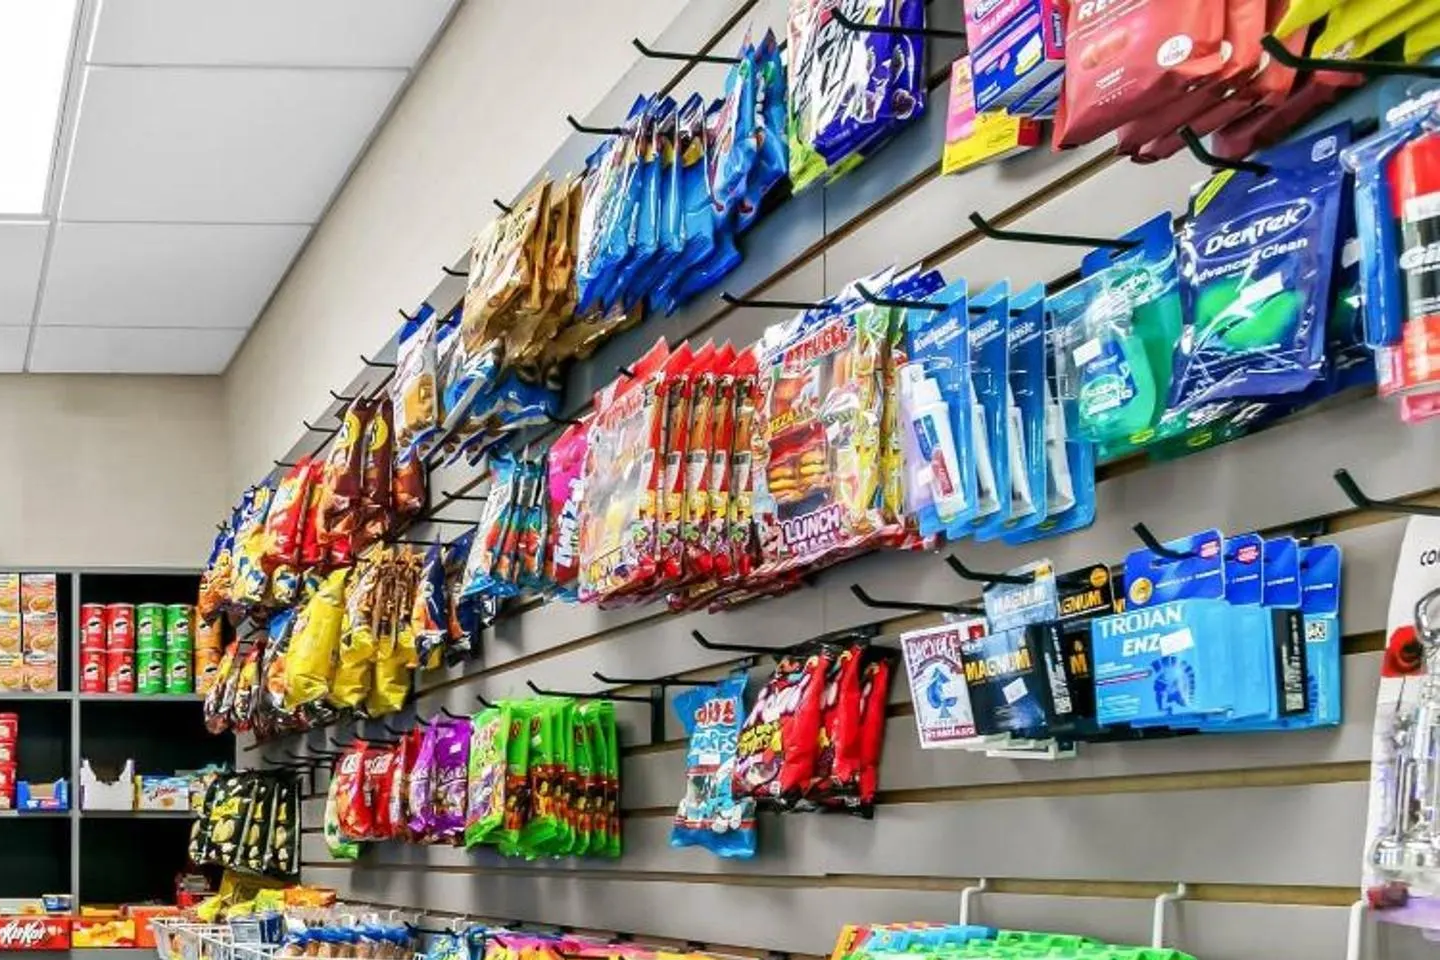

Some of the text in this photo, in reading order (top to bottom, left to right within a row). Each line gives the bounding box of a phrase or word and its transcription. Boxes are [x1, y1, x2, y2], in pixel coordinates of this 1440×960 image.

[1261, 235, 1309, 260] Clean
[783, 504, 840, 545] LUNCH
[1062, 588, 1102, 614] GNUM
[1098, 604, 1183, 639] TROJAN
[965, 648, 1031, 684] MAGNUM
